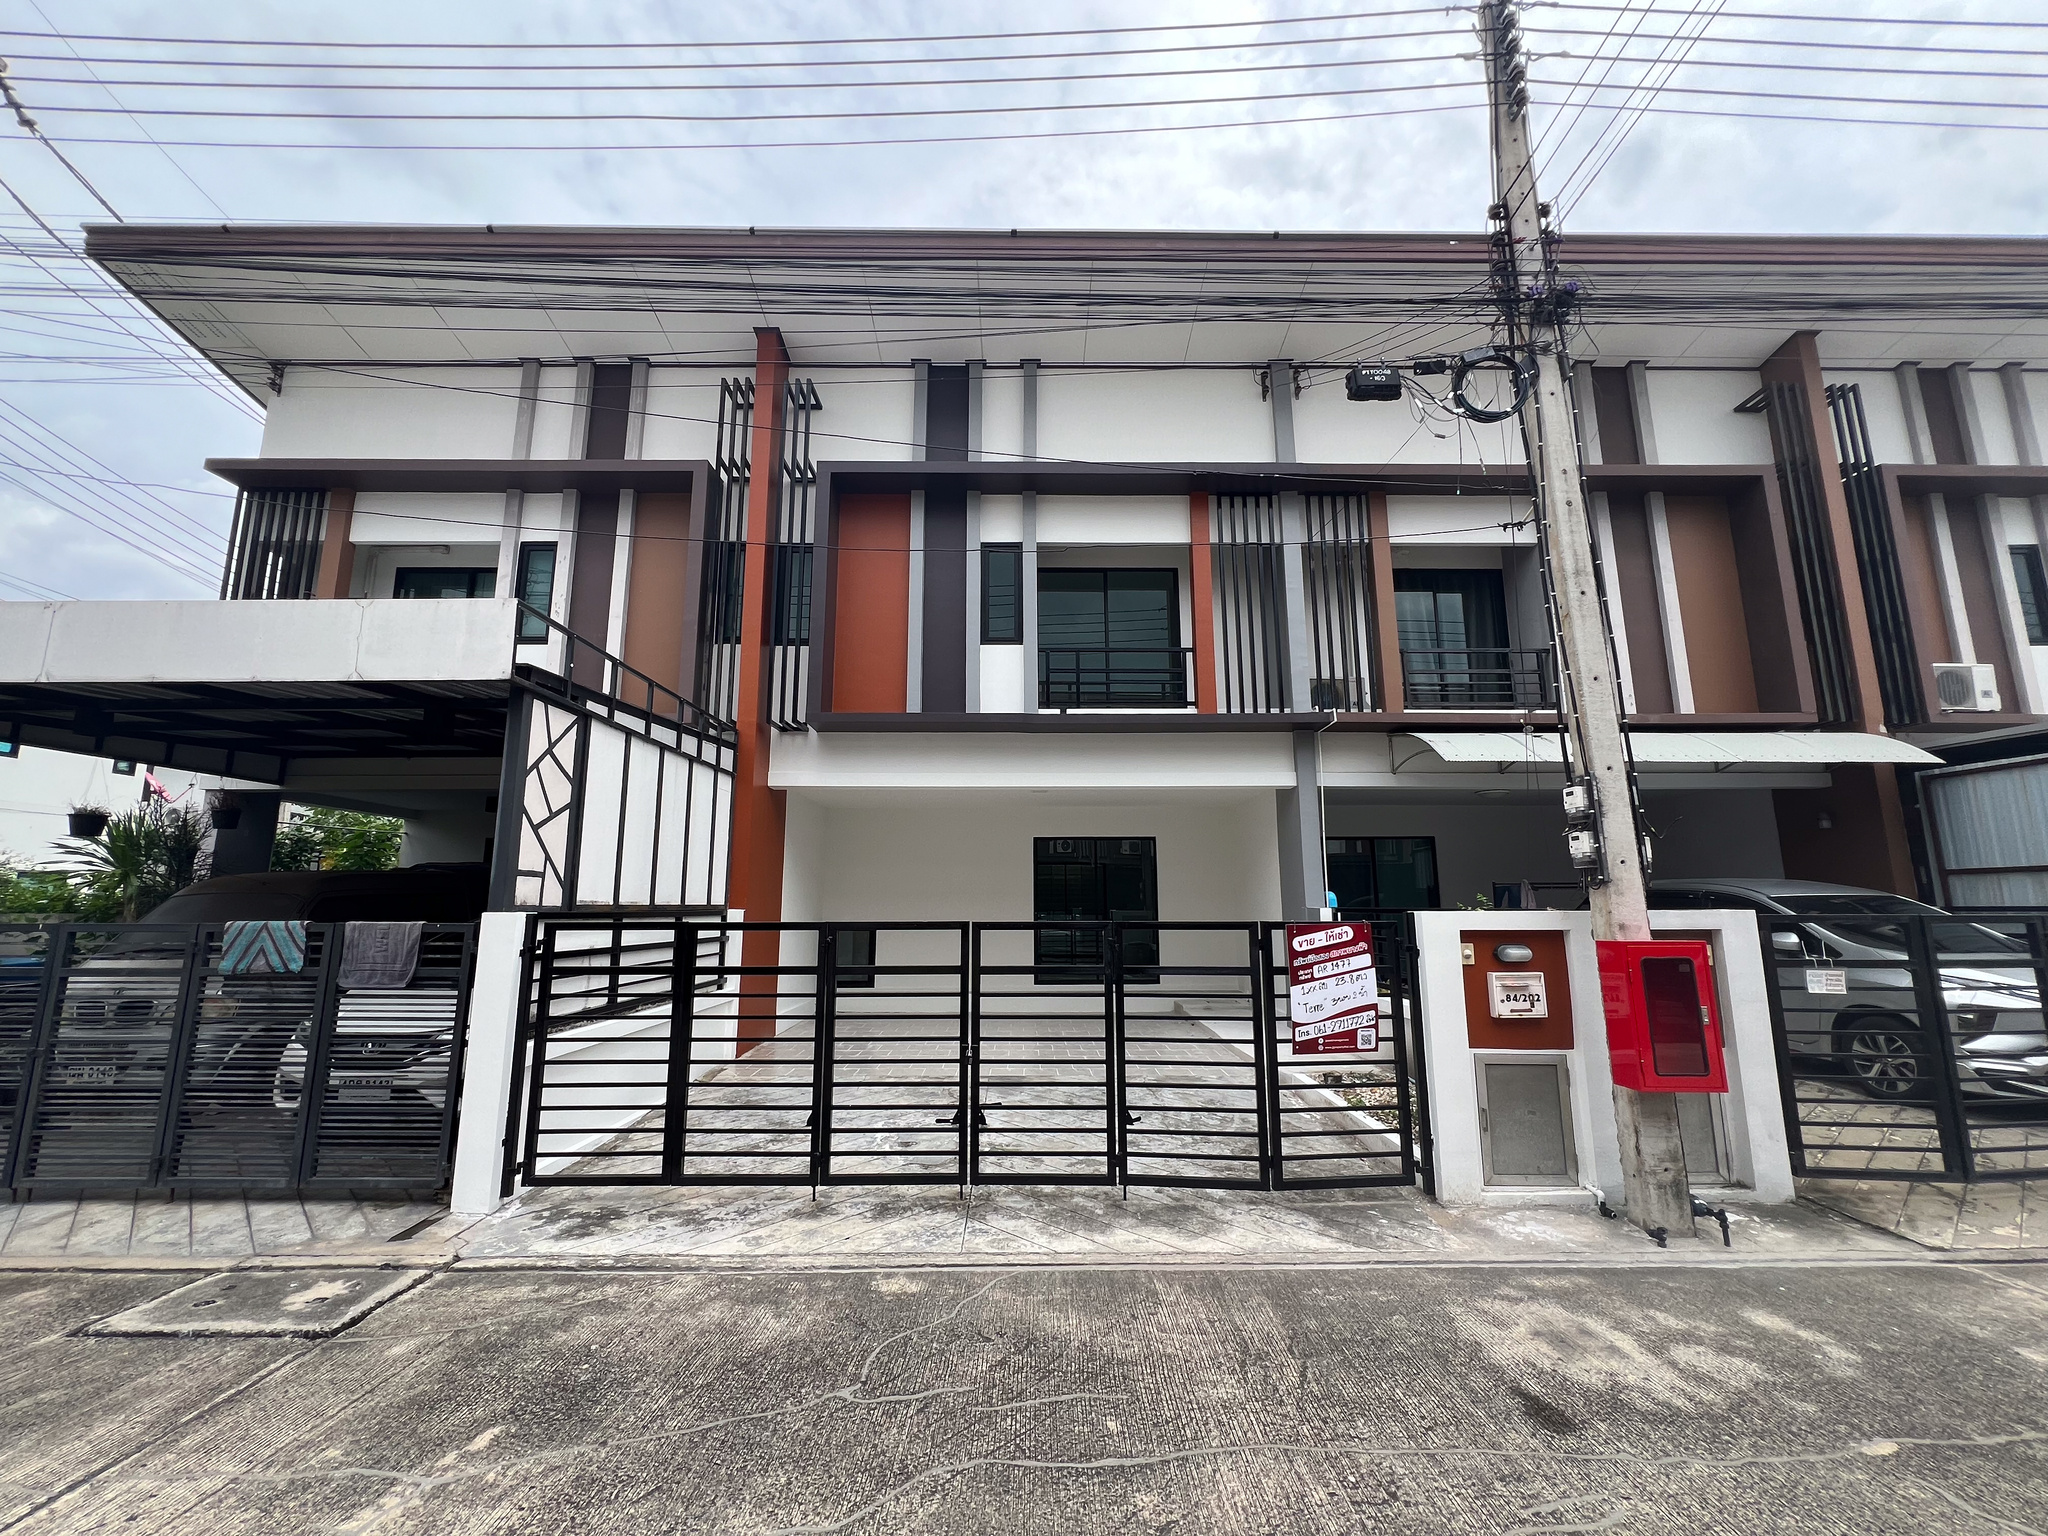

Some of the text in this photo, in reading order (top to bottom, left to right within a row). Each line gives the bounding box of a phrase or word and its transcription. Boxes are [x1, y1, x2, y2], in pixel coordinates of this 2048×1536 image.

[1297, 937, 1315, 948] ขาย
[1325, 929, 1349, 943] ให้เช่า
